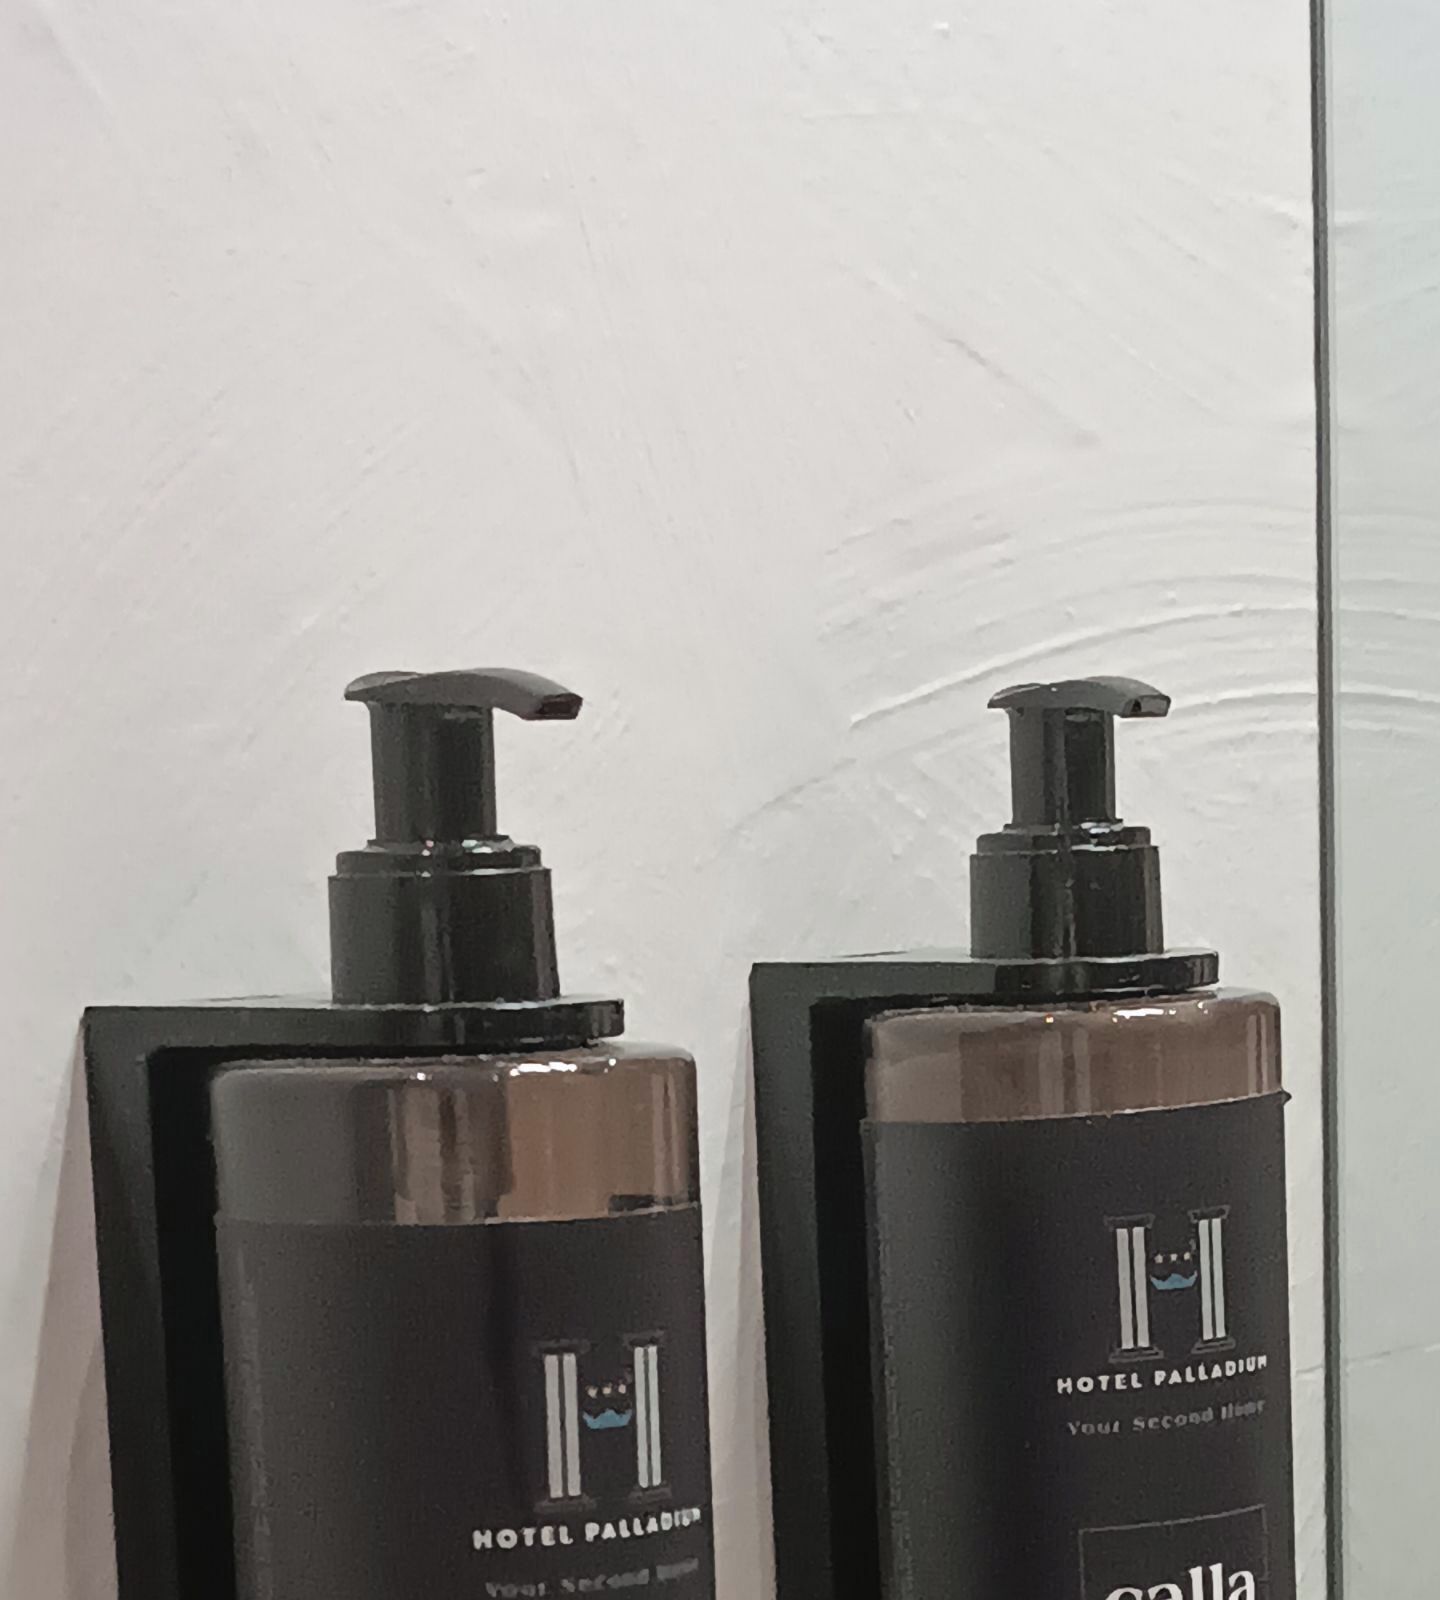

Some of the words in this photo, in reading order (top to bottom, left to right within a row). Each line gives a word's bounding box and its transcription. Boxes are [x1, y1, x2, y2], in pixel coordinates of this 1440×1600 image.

[1057, 1372, 1142, 1395] HOTEL
[1154, 1355, 1268, 1386] PALLADIUM
[1133, 1407, 1214, 1432] Second
[472, 1525, 575, 1551] HOTEL
